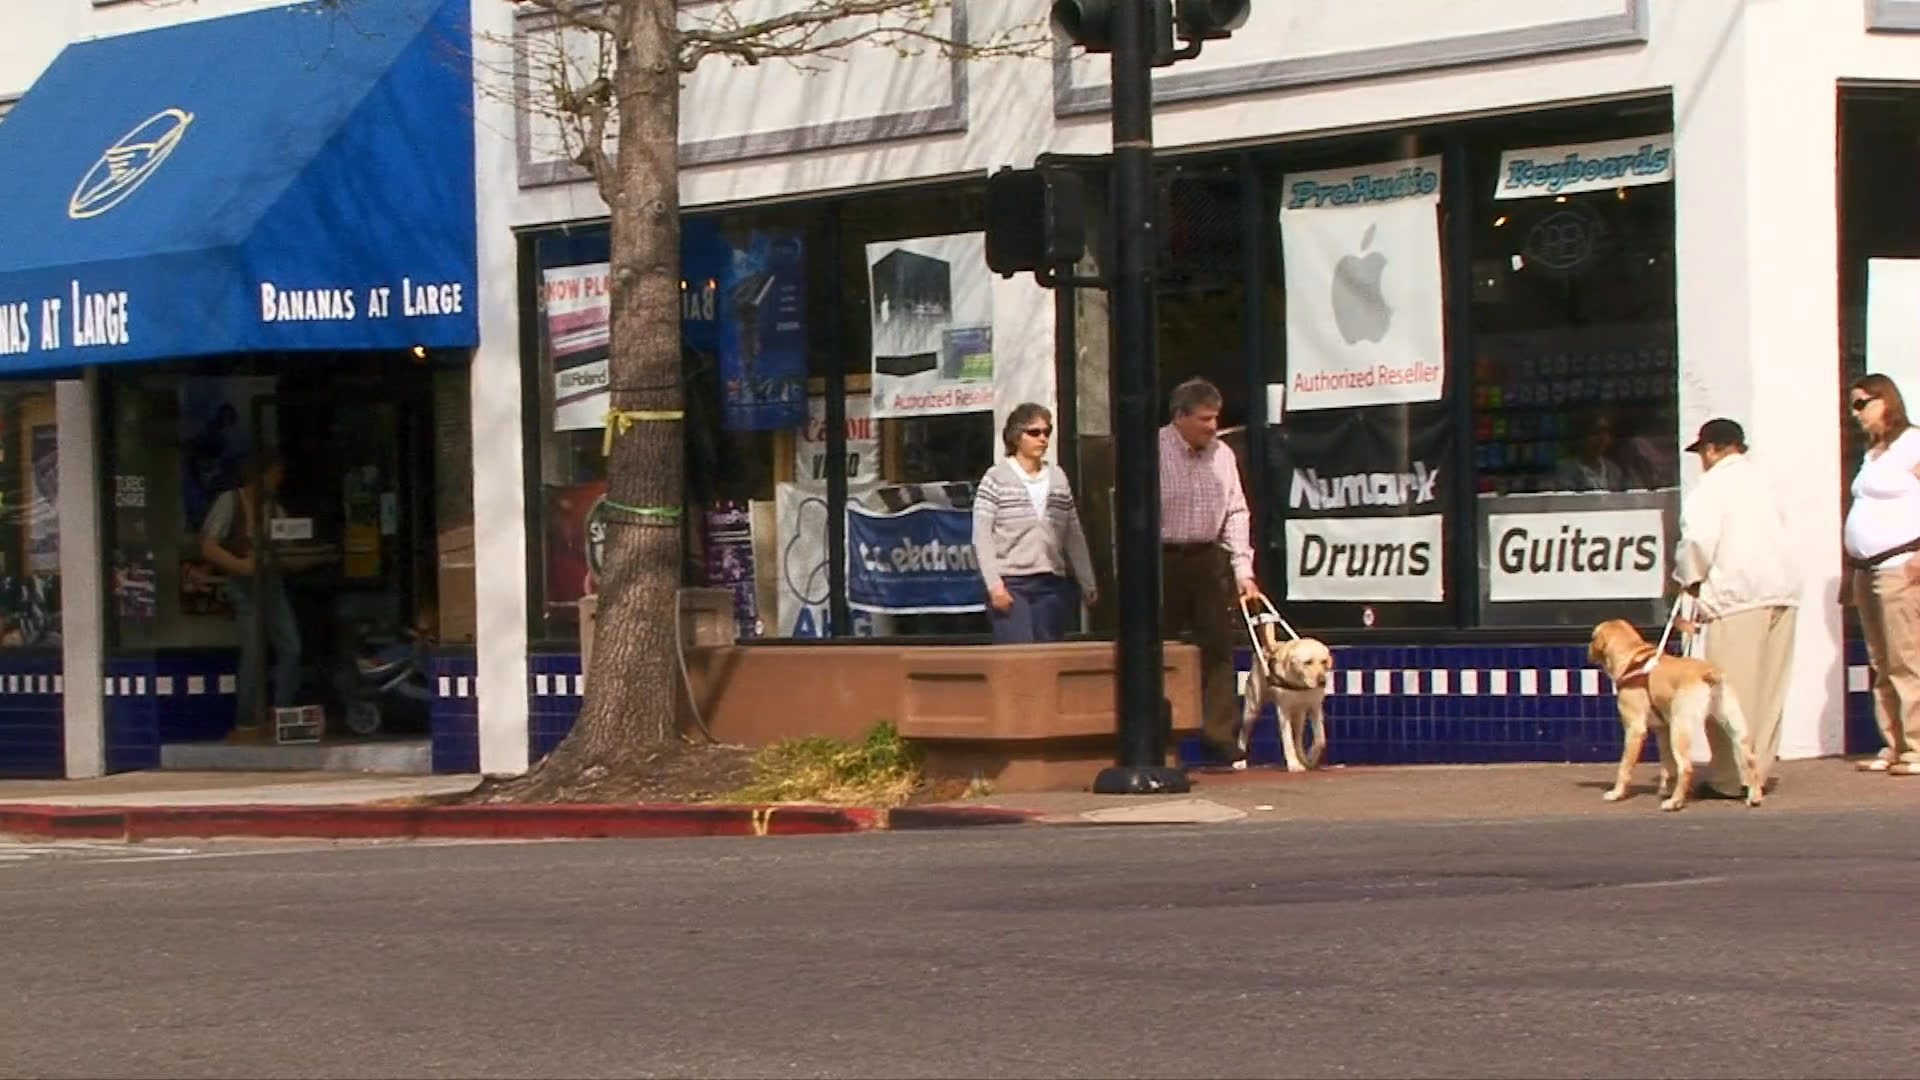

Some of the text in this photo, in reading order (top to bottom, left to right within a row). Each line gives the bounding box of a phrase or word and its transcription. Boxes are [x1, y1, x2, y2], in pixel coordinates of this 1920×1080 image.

[1506, 144, 1671, 192] Keyboards
[261, 277, 463, 321] BANANAS AT LARGE
[545, 280, 579, 301] NOW
[41, 298, 61, 351] AT
[72, 279, 129, 346] LARGE
[955, 385, 993, 407] Reselle
[1294, 361, 1440, 392] Authorized Reseller
[803, 416, 871, 442] Caon
[1289, 461, 1440, 511] Numark
[1300, 533, 1431, 578] Drums
[1499, 524, 1657, 574] Guitars
